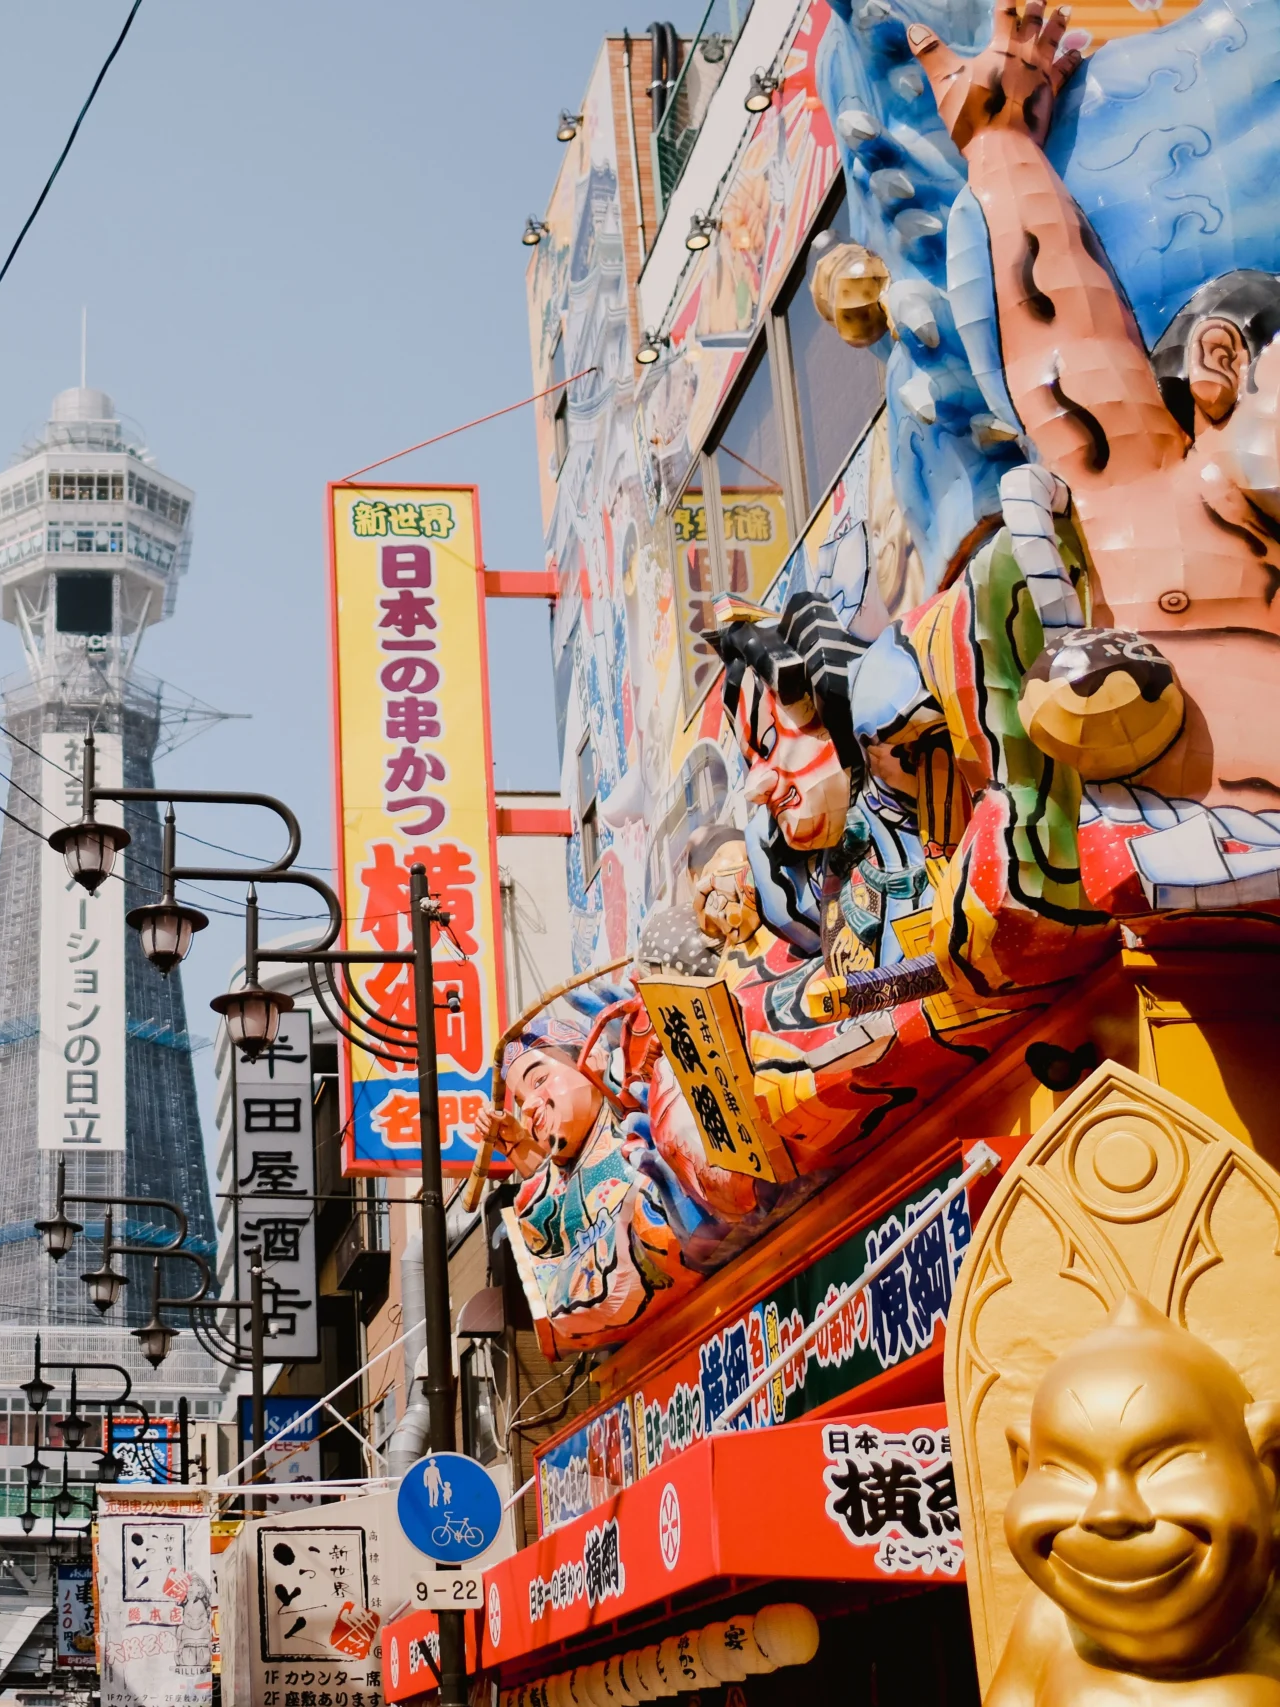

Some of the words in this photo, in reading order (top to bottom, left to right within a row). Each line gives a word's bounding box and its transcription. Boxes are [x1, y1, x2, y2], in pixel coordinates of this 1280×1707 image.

[352, 501, 455, 538] 新世界
[378, 544, 446, 837] 日本一の串かつ
[62, 738, 102, 1145] 社会ーションの日立
[360, 842, 485, 1078] 横綱
[377, 1095, 485, 1144] 名門
[867, 1195, 953, 1363] 横綱
[416, 1579, 478, 1602] 9-22
